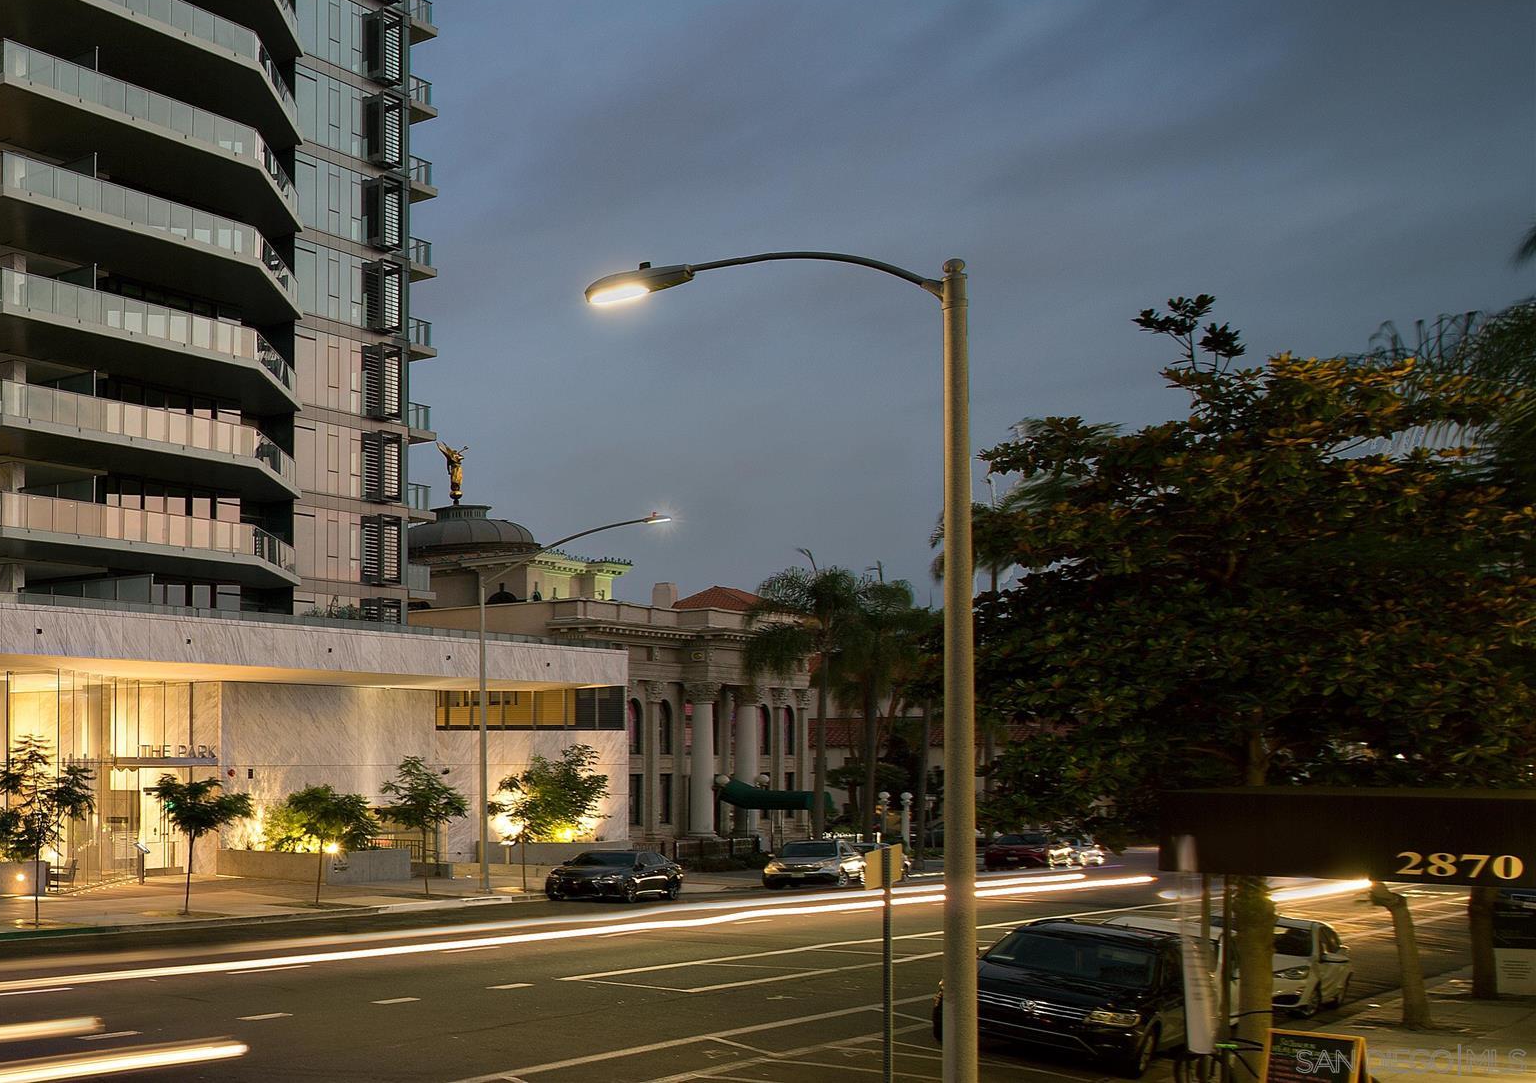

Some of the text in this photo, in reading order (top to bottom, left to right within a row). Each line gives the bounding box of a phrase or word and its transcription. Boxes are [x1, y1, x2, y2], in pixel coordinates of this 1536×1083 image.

[142, 745, 216, 758] THE PARK
[1395, 851, 1524, 880] 2870
